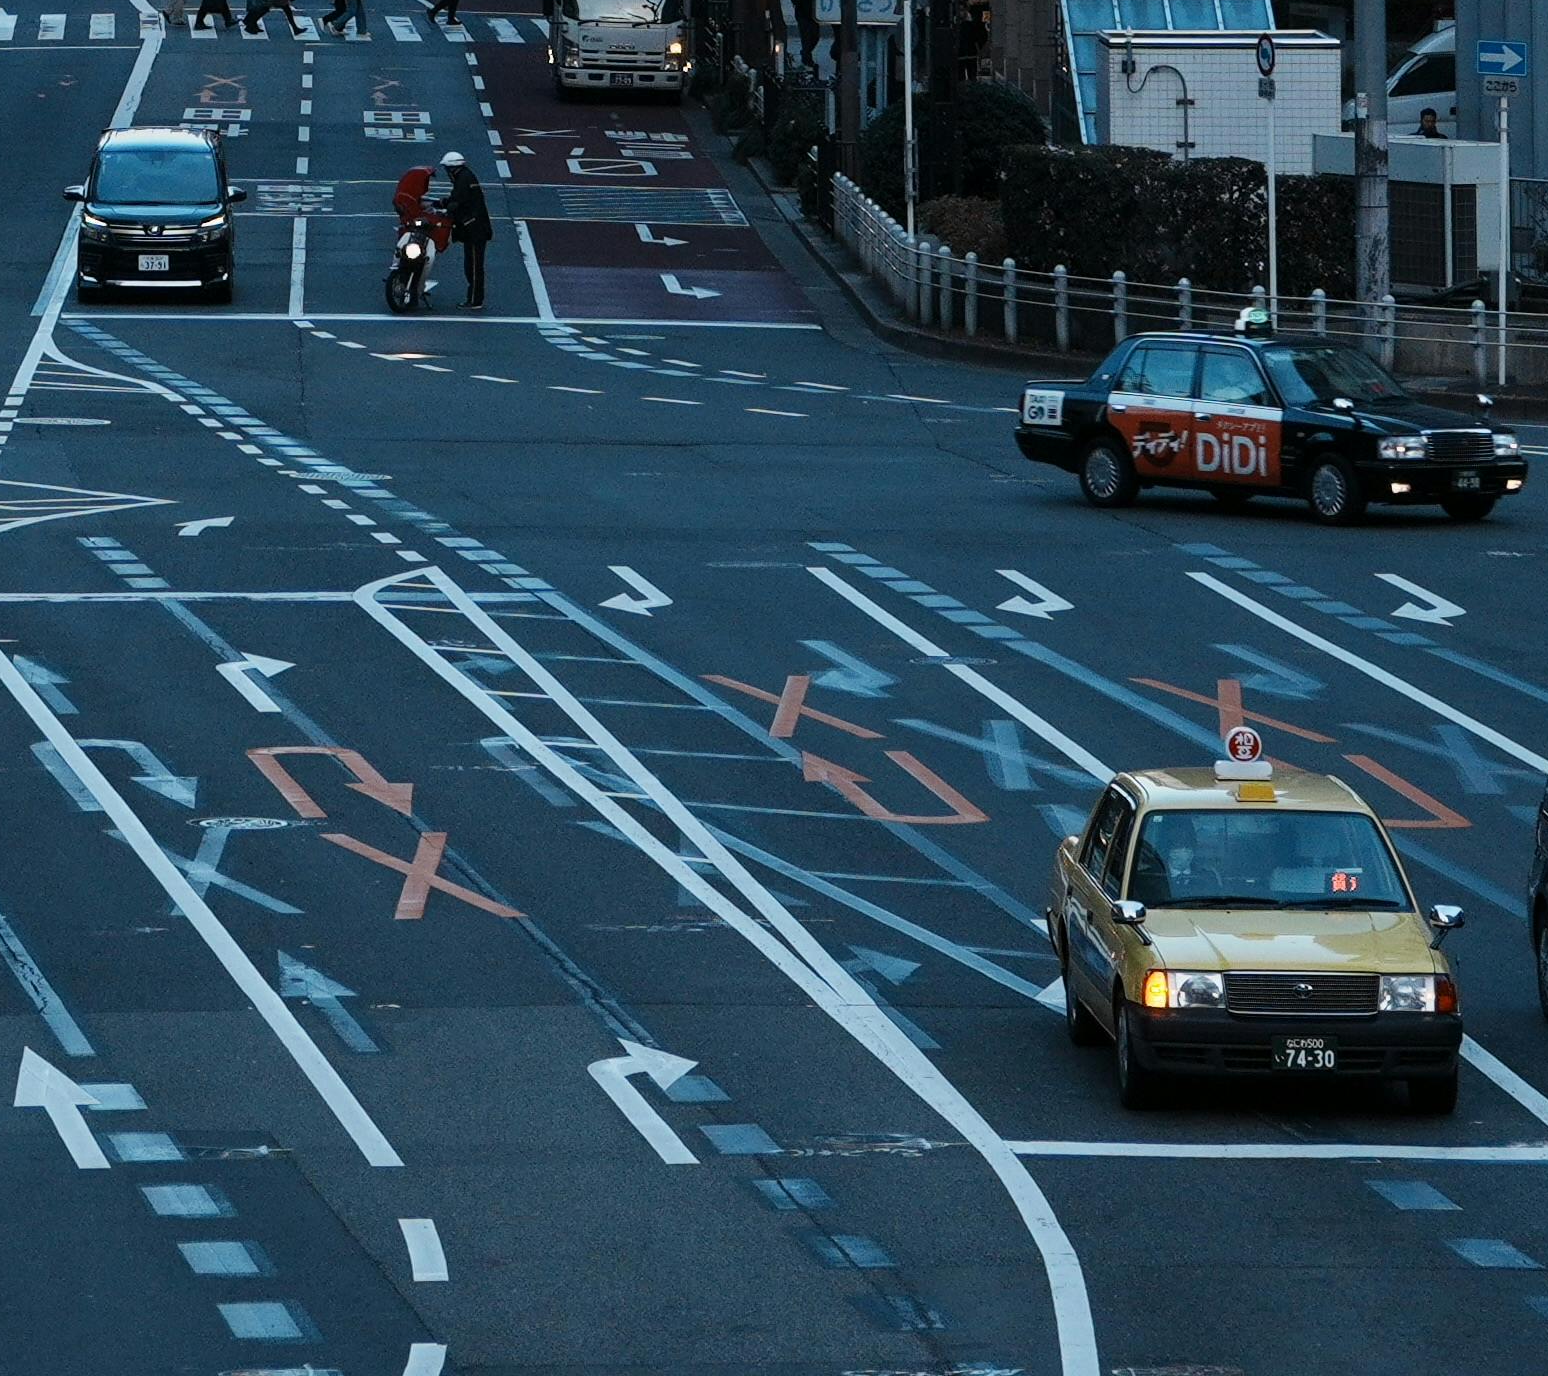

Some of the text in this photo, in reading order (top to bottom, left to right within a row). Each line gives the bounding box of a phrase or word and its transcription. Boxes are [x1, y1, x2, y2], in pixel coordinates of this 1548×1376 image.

[1486, 78, 1519, 93] ここから
[1196, 433, 1268, 476] DiDi
[1286, 1050, 1335, 1068] 74-30
